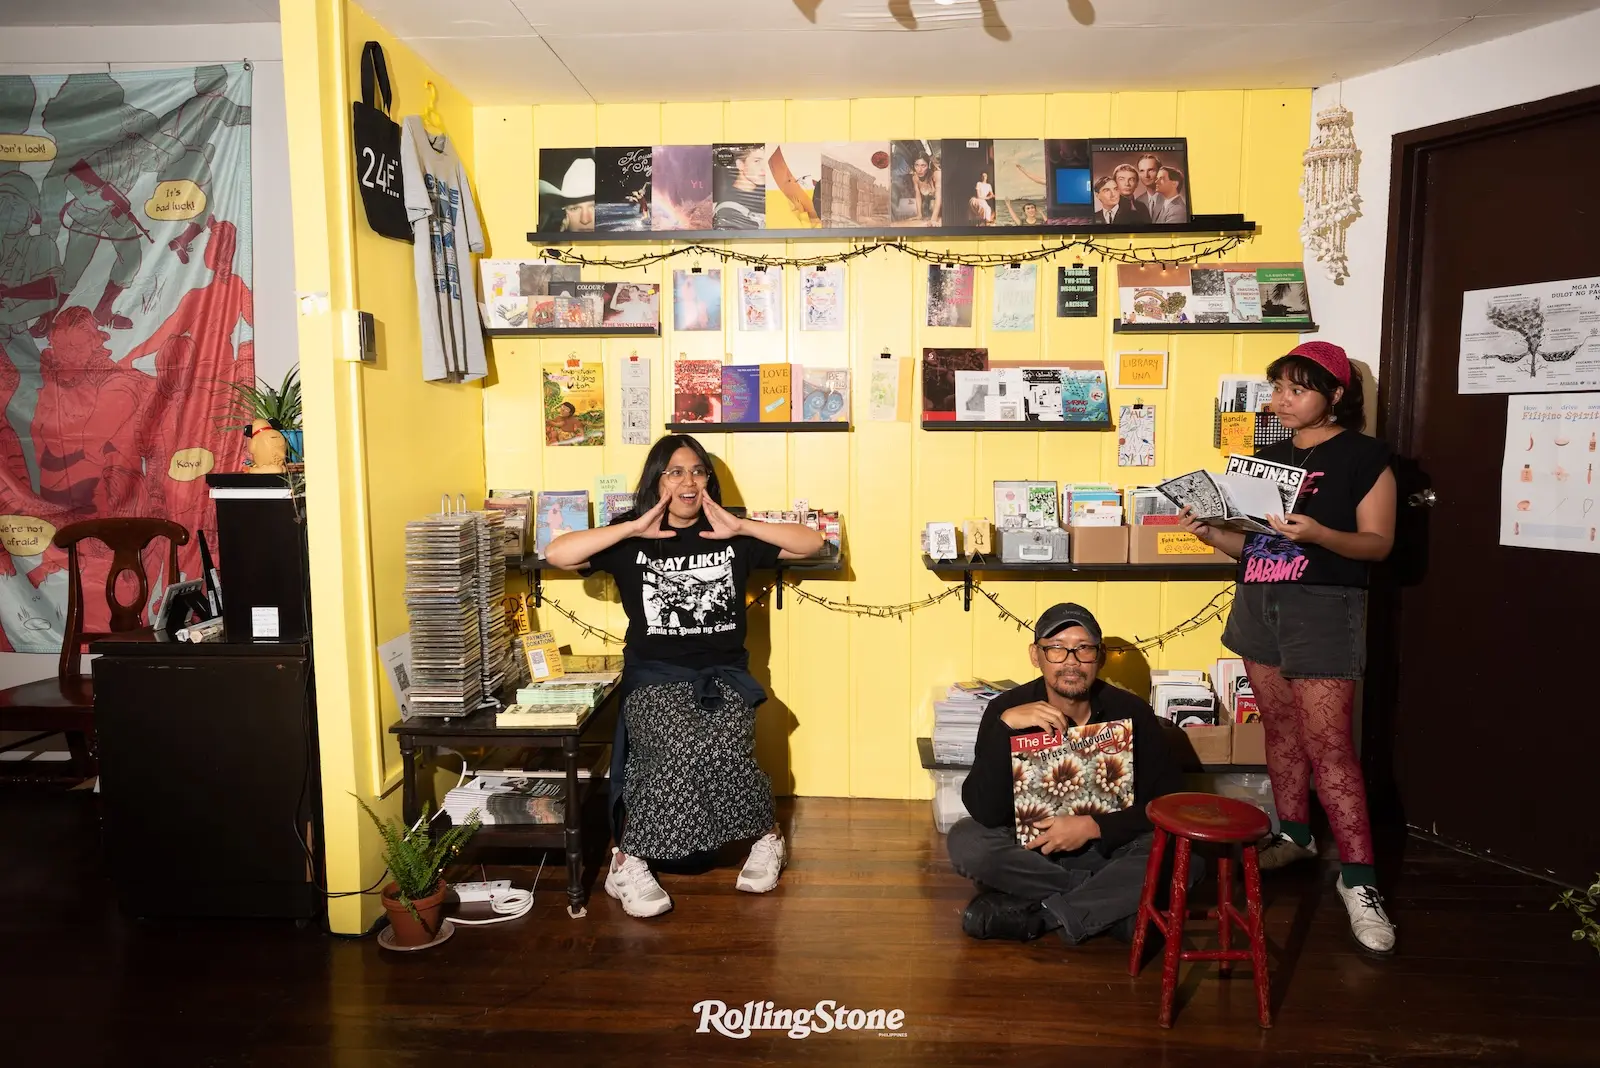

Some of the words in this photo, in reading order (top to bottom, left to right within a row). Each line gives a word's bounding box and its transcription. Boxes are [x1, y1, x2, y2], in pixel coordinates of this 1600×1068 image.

[25, 145, 47, 154] look!
[166, 188, 181, 198] It's
[156, 203, 170, 212] bad
[172, 202, 196, 212] luck!
[1122, 358, 1159, 370] LIBRARY
[762, 368, 788, 379] LOVE
[1132, 371, 1151, 380] UNA
[762, 385, 788, 395] RAGE
[1223, 415, 1248, 423] Handle
[1522, 411, 1562, 422] Filipino
[1228, 457, 1300, 486] PILIPINAS
[26, 525, 43, 533] not
[688, 545, 736, 569] LIKHA
[525, 631, 552, 641] PAYMENTS
[646, 625, 668, 636] Mula
[678, 626, 702, 637] Pusod
[703, 626, 714, 635] ng
[525, 637, 556, 648] DONATIONS
[1016, 736, 1040, 749] The
[1042, 733, 1058, 745] Ex
[1040, 746, 1068, 761] Brass
[1069, 727, 1113, 751] Unbound
